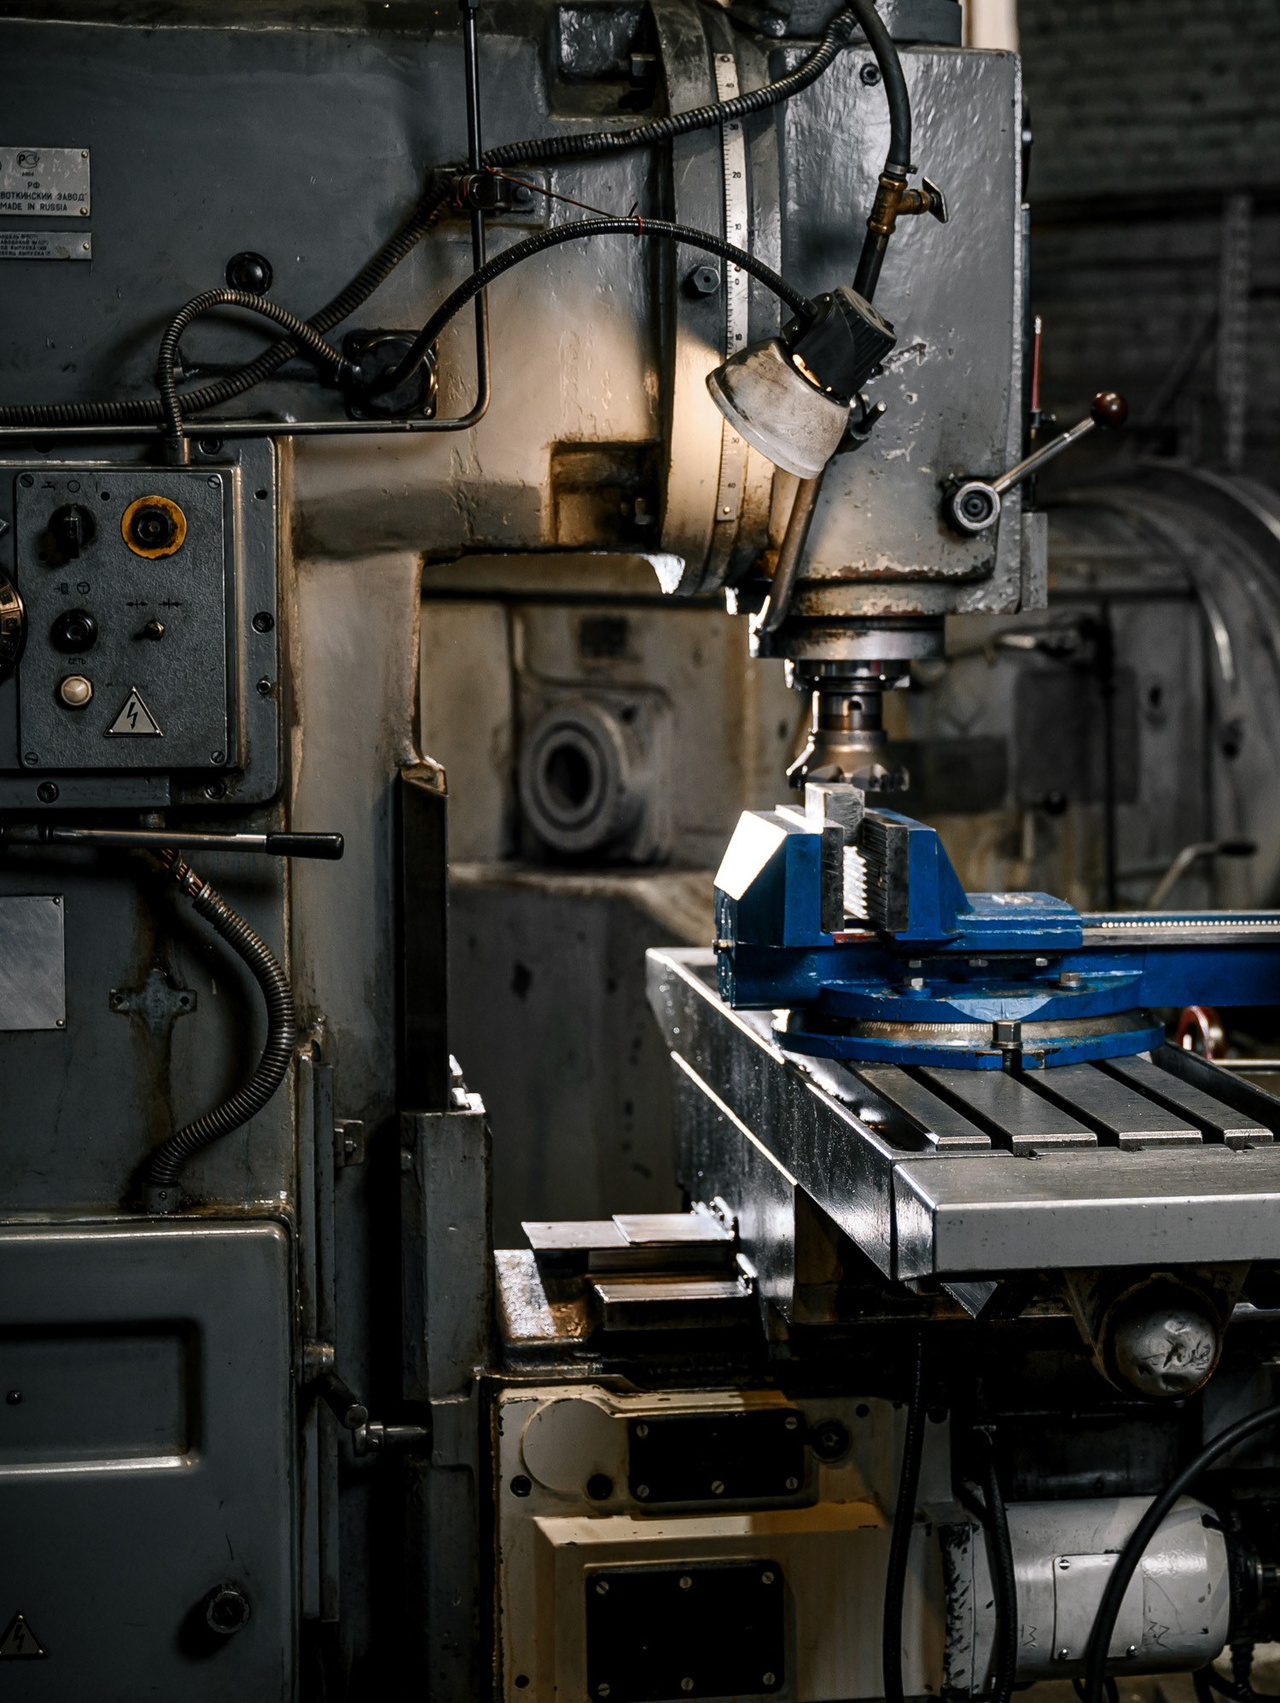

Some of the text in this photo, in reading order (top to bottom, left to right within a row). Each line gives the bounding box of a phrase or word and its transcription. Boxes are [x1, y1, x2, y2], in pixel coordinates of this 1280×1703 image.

[729, 123, 739, 131] 30
[732, 171, 742, 179] 20
[27, 181, 41, 189] РФ
[0, 202, 68, 212] MADE IN RUSSIA
[734, 223, 742, 231] 10
[734, 278, 740, 286] 0
[735, 333, 743, 341] 10
